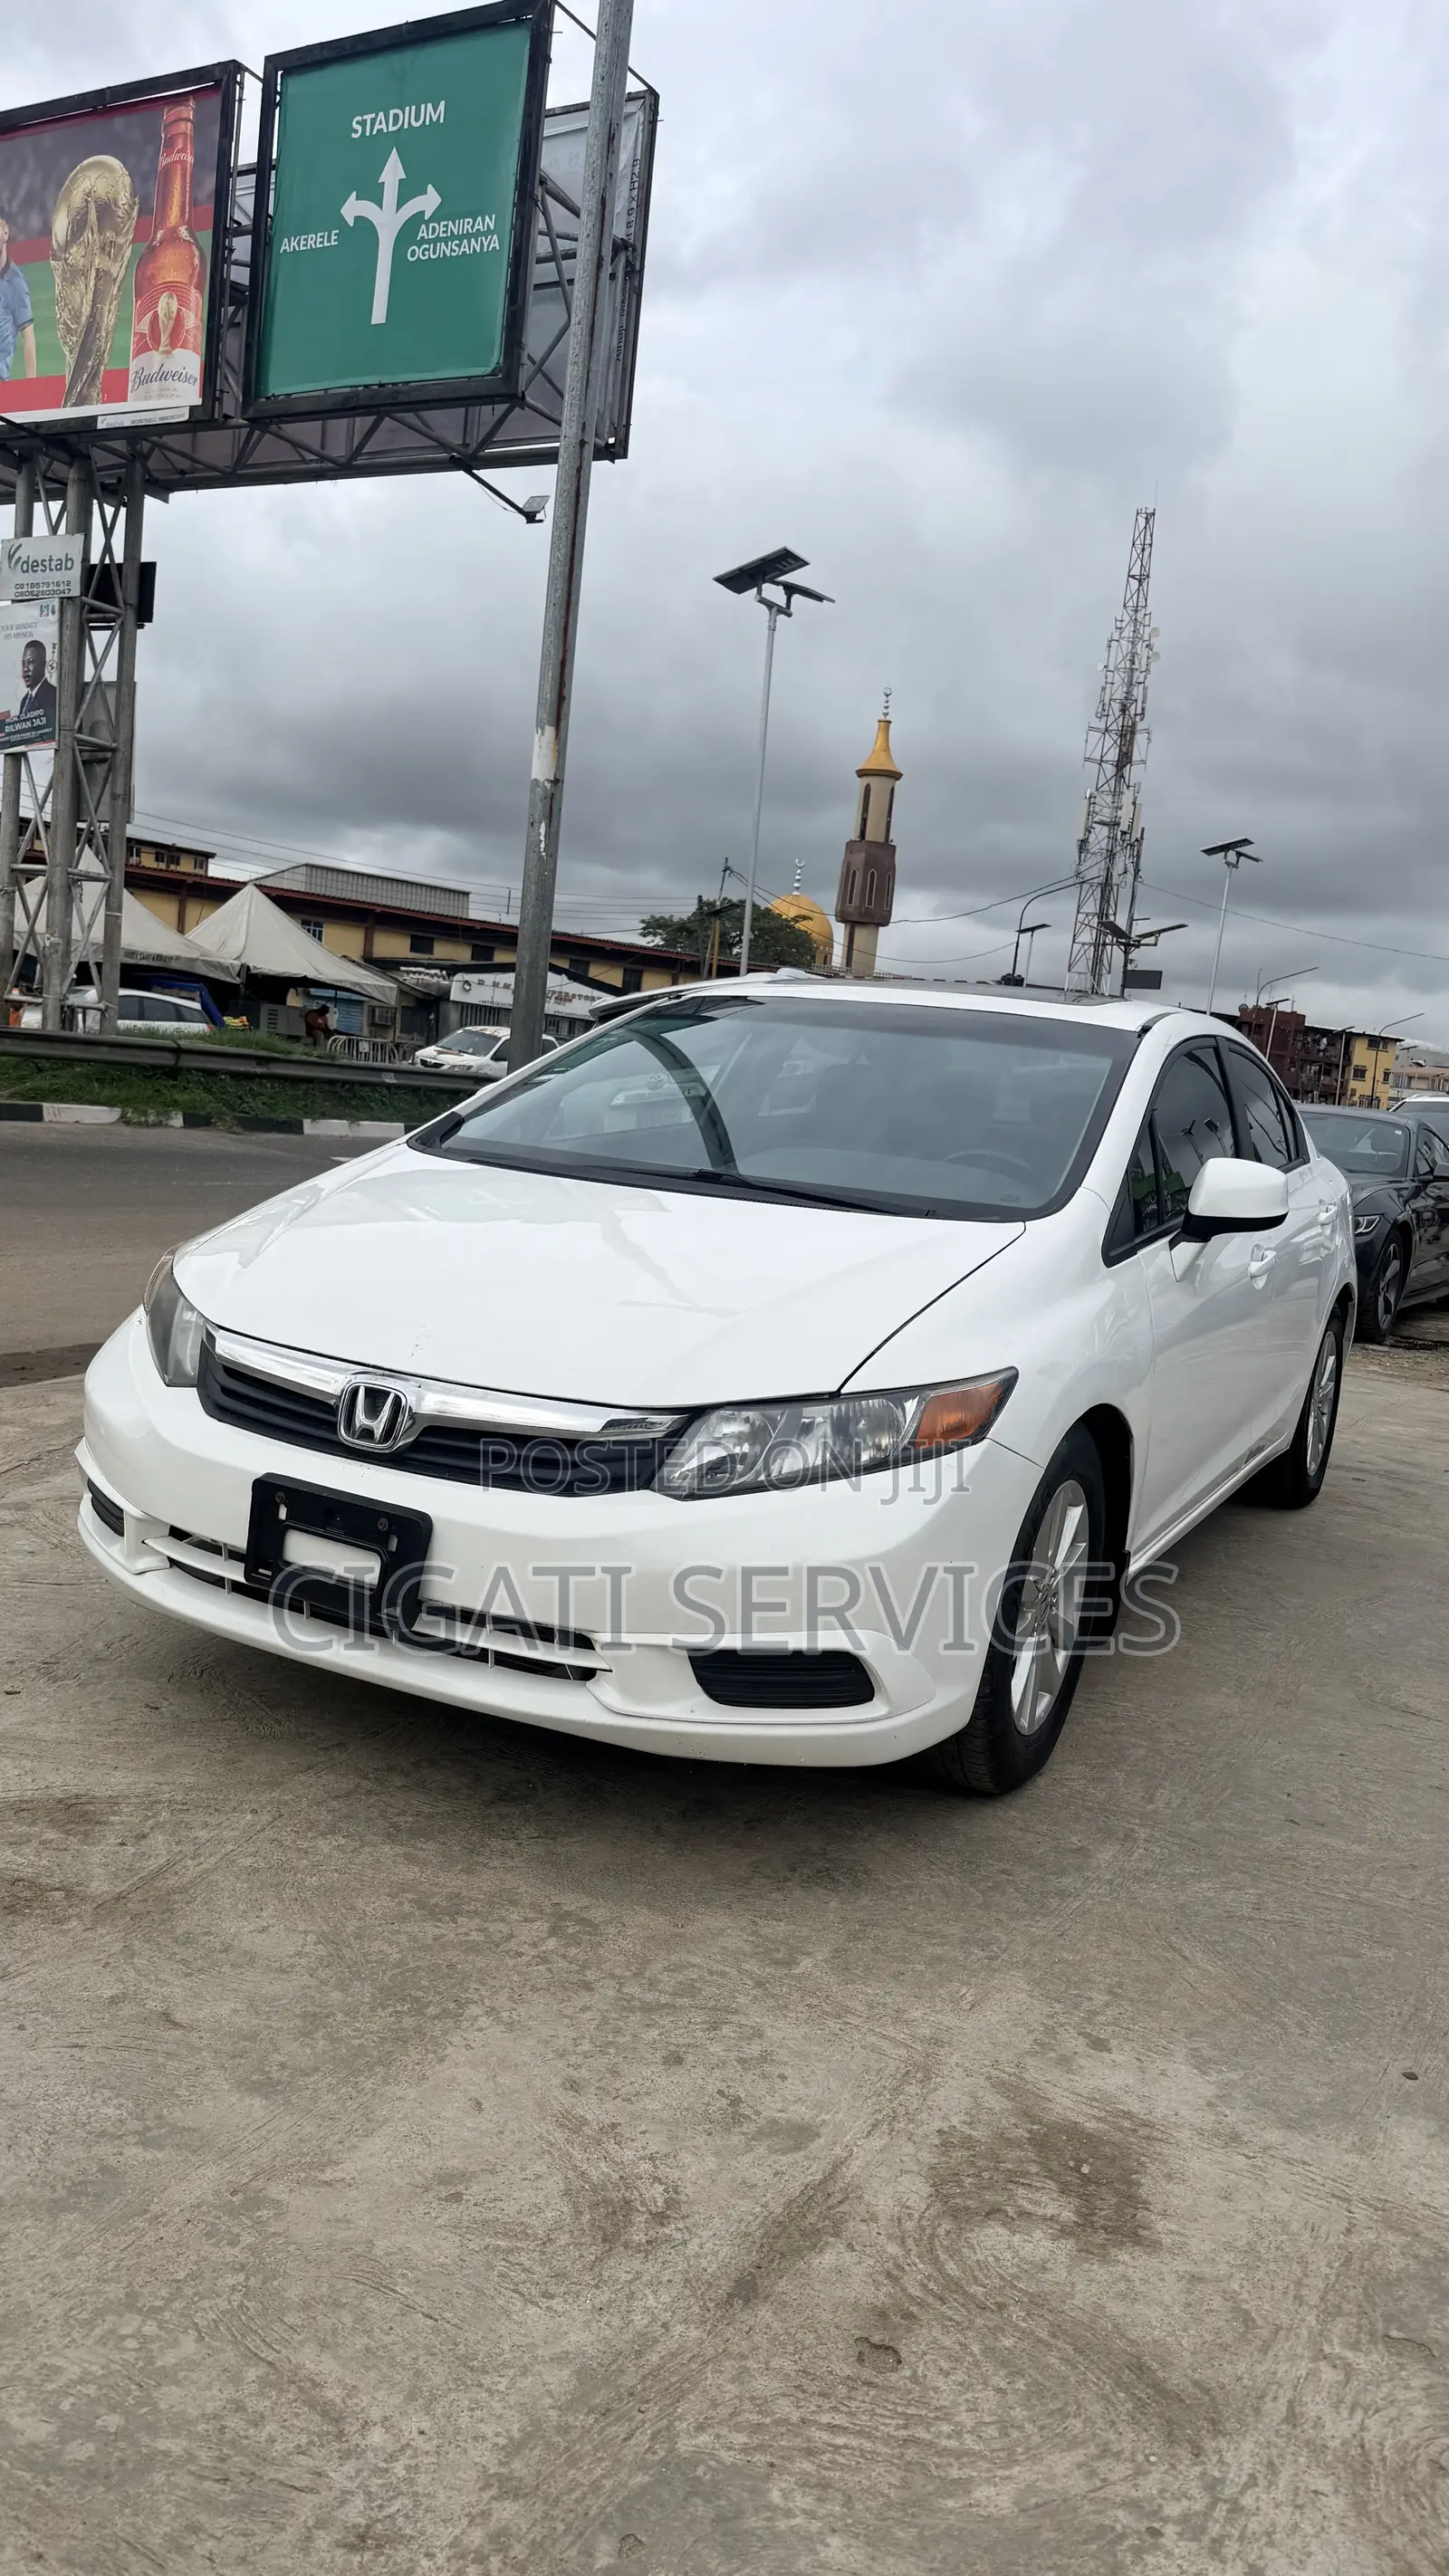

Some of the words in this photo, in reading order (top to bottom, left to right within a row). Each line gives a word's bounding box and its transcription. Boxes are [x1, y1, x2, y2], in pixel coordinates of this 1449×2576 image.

[350, 100, 446, 139] STADIUM
[417, 214, 496, 241] ADENIRAN
[280, 230, 340, 254] AKERELE
[407, 234, 500, 262] OGUNSANYA
[130, 363, 198, 394] Budweiser
[21, 553, 74, 573] destab
[5, 720, 32, 733] RILWAN
